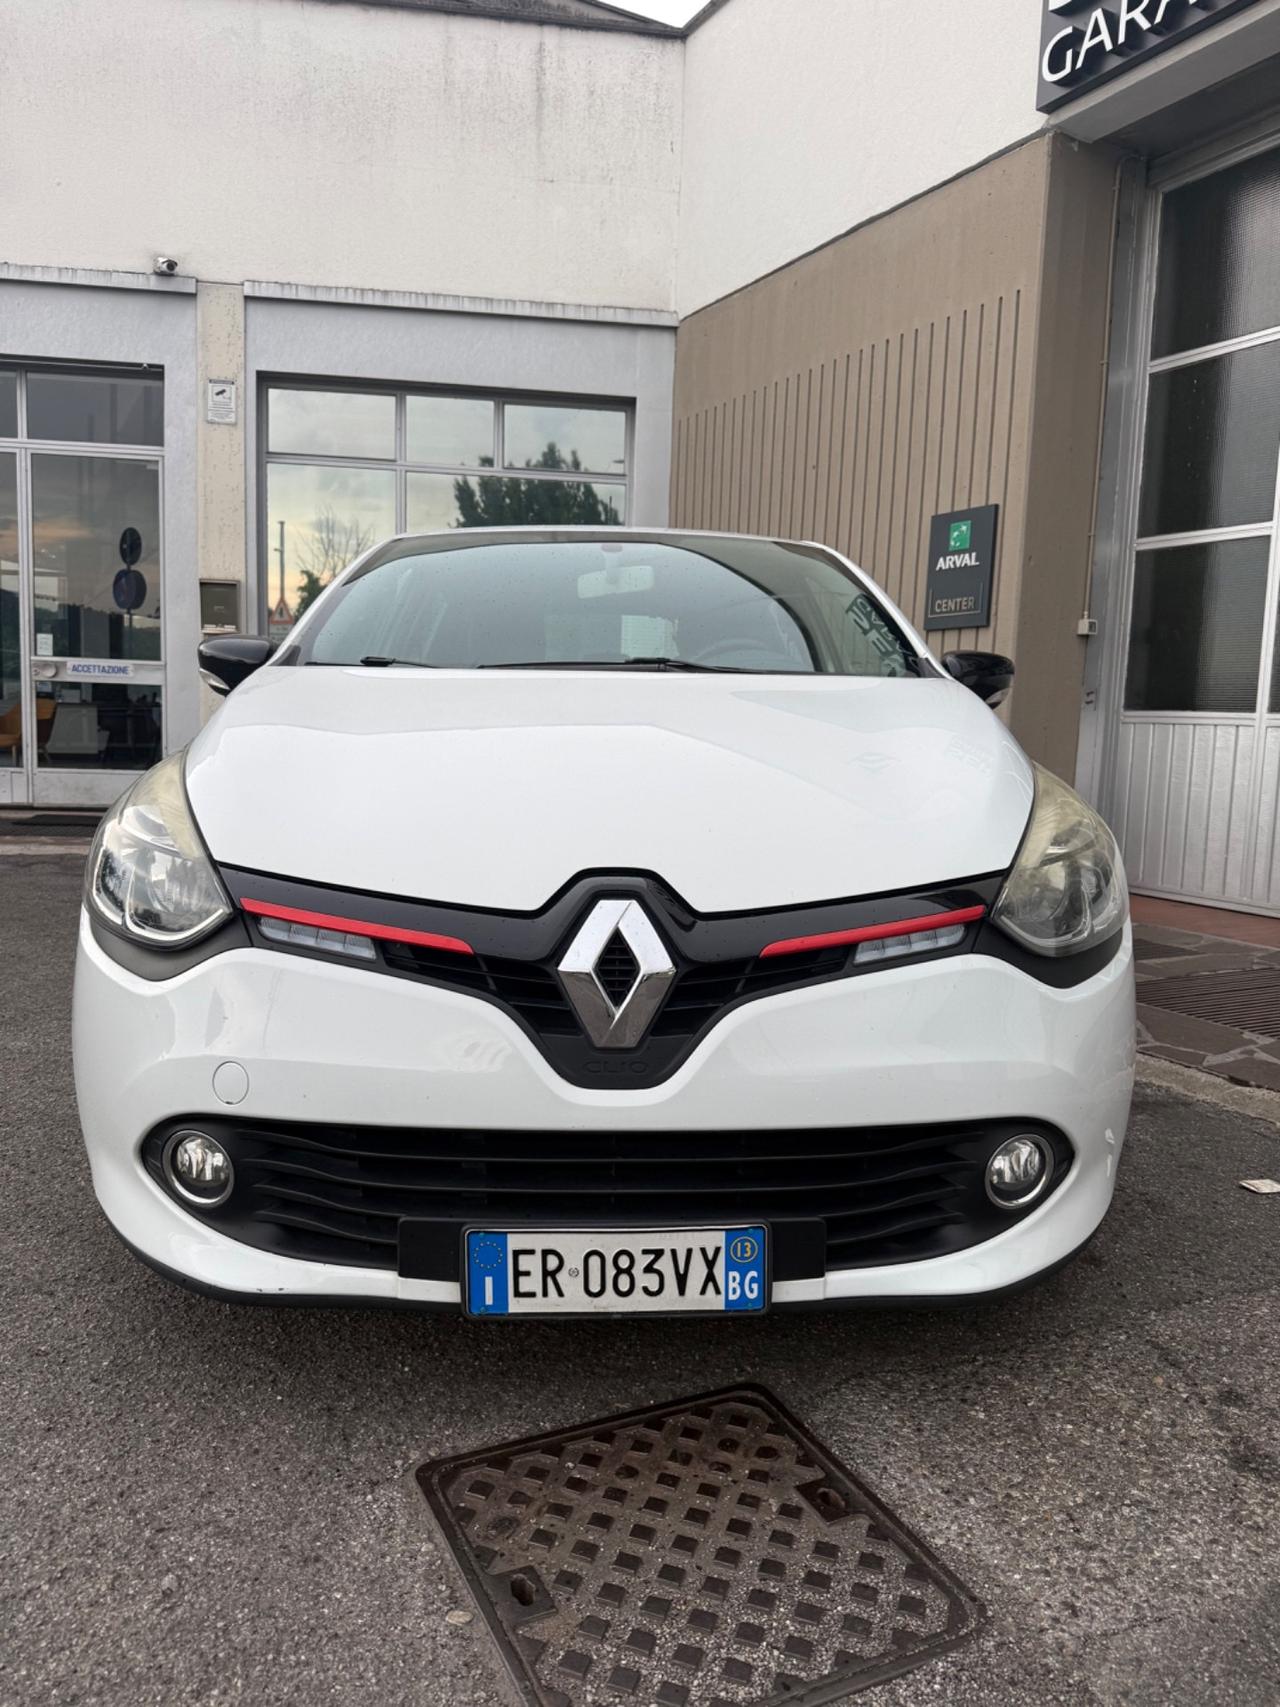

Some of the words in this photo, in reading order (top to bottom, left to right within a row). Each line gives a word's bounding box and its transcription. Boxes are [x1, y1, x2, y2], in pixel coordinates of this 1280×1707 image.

[936, 552, 979, 571] ARVAL
[935, 597, 974, 612] CENTER
[71, 664, 129, 675] ACCETTAZIONE
[736, 1242, 752, 1258] 13
[728, 1270, 759, 1300] BG
